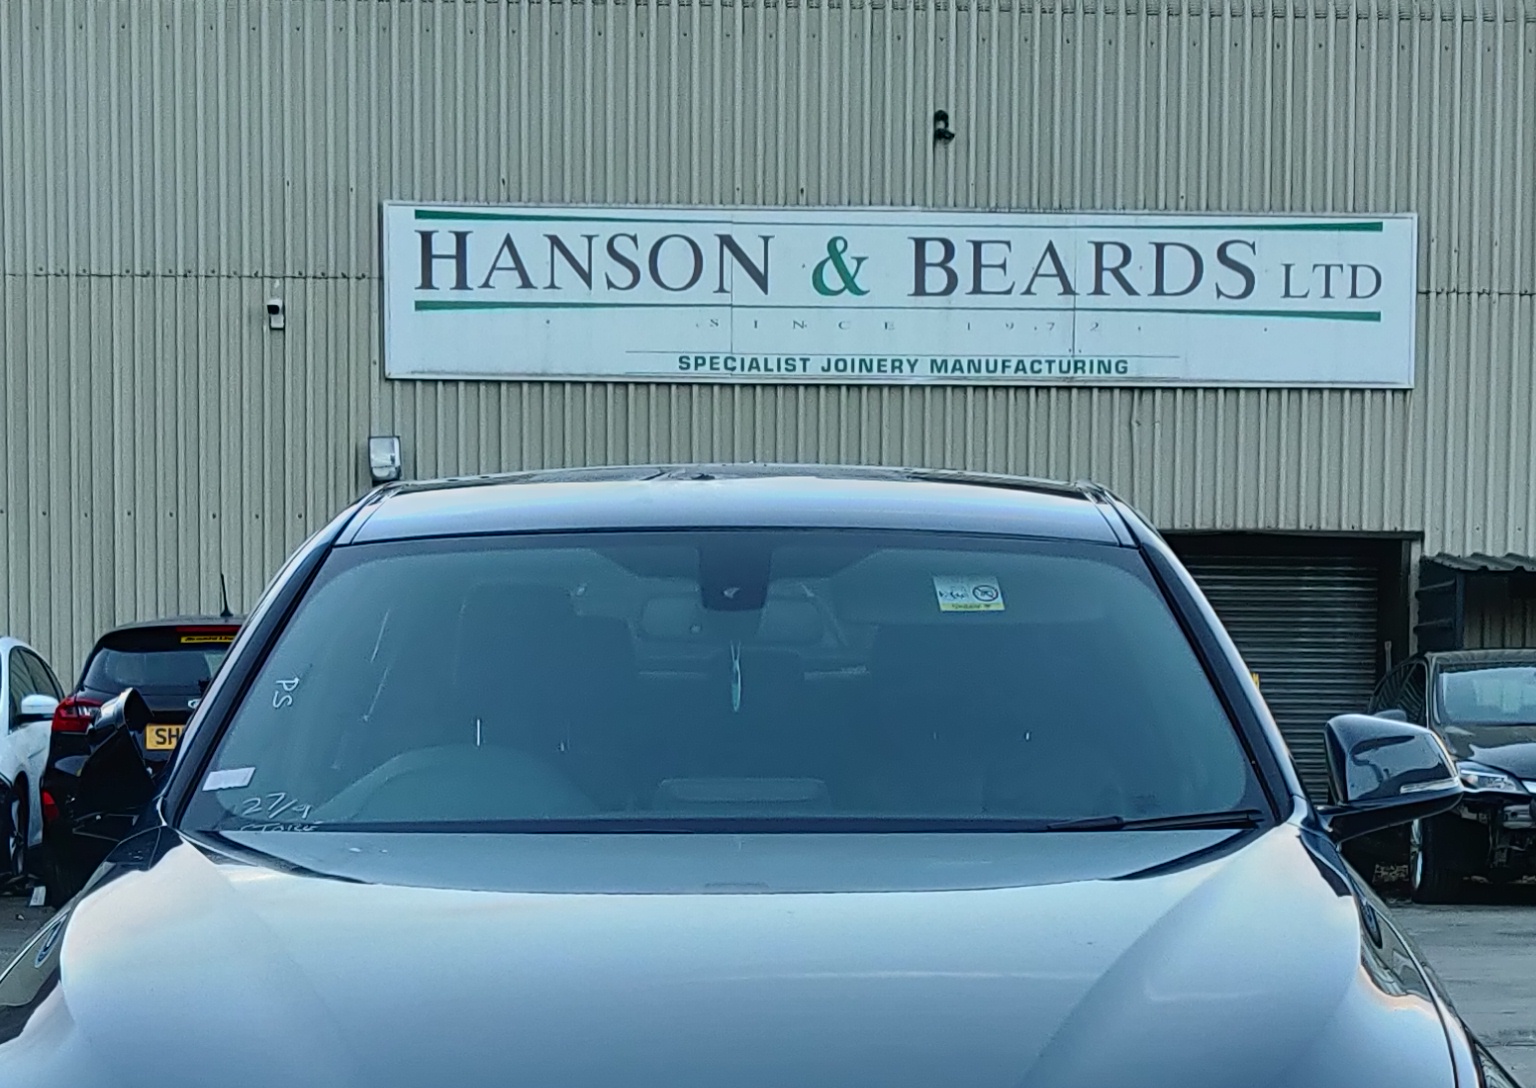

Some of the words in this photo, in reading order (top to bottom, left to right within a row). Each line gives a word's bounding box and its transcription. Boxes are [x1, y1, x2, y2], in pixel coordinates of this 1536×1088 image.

[414, 229, 776, 297] HANSON
[811, 235, 870, 297] &
[906, 235, 1257, 300] BEARDS
[1281, 262, 1383, 299] LTD
[678, 354, 812, 374] SPECIALIST
[820, 357, 920, 374] JOINERY
[929, 358, 1130, 375] MANUFACTURING
[154, 727, 184, 746] SH
